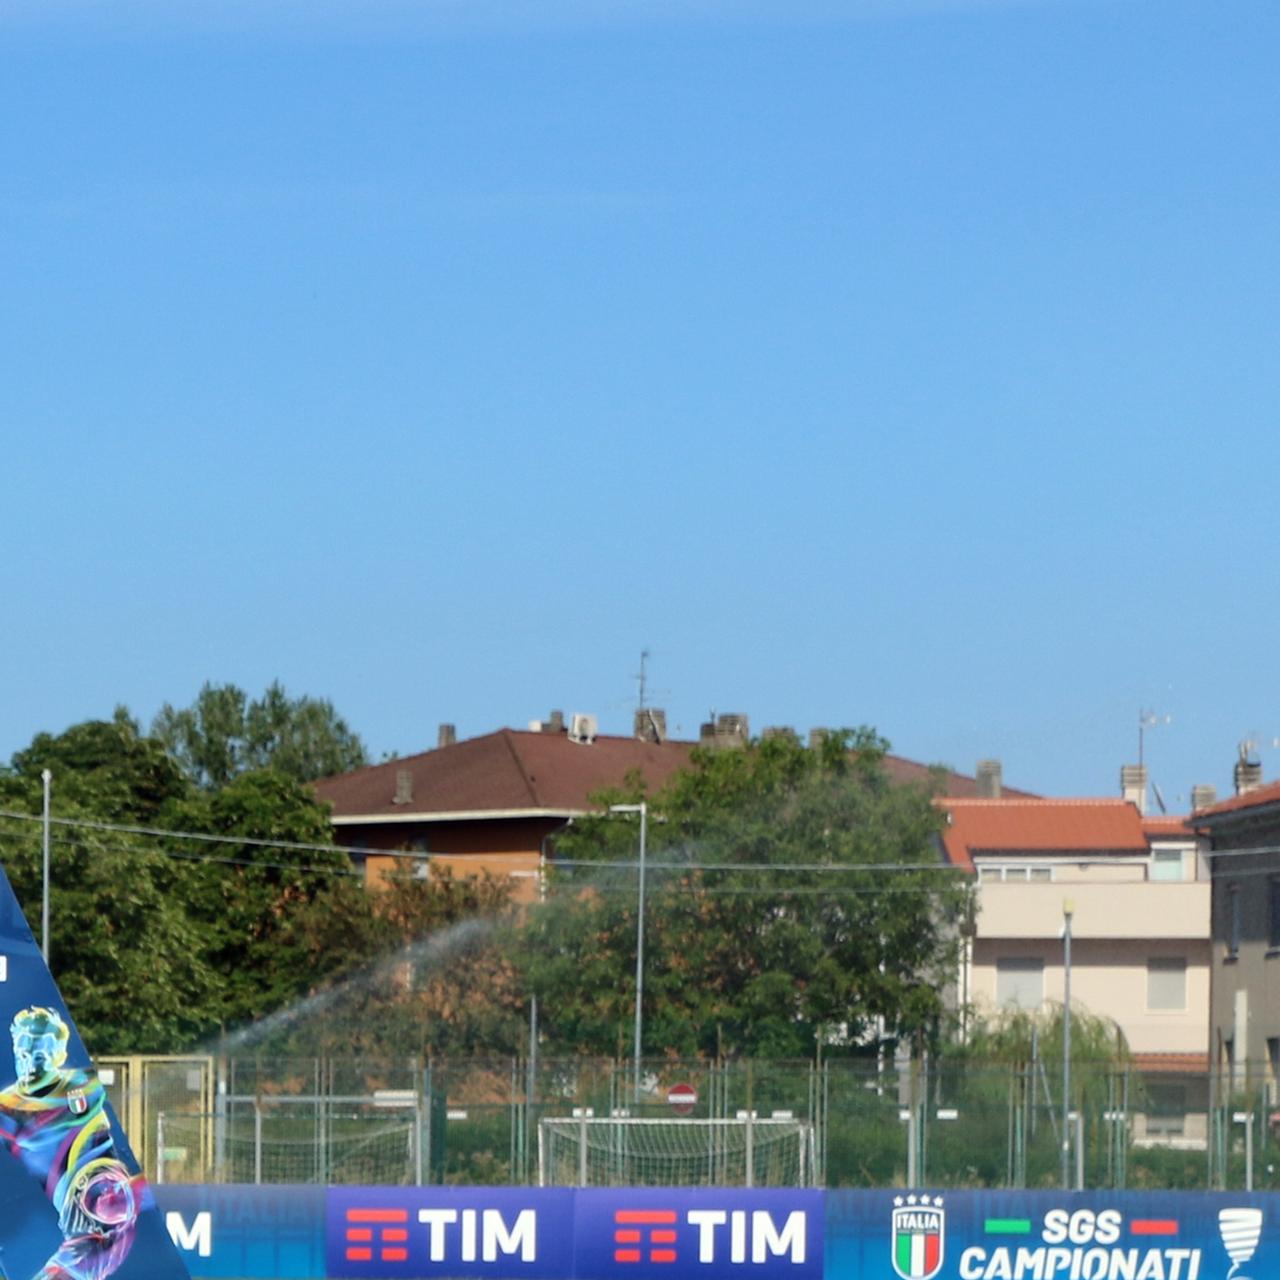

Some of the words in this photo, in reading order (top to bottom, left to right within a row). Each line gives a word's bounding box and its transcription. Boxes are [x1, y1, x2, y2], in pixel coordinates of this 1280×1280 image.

[419, 1209, 537, 1262] TIM
[688, 1210, 806, 1263] TIM
[896, 1214, 939, 1230] ITALIA
[1042, 1209, 1122, 1244] SGS
